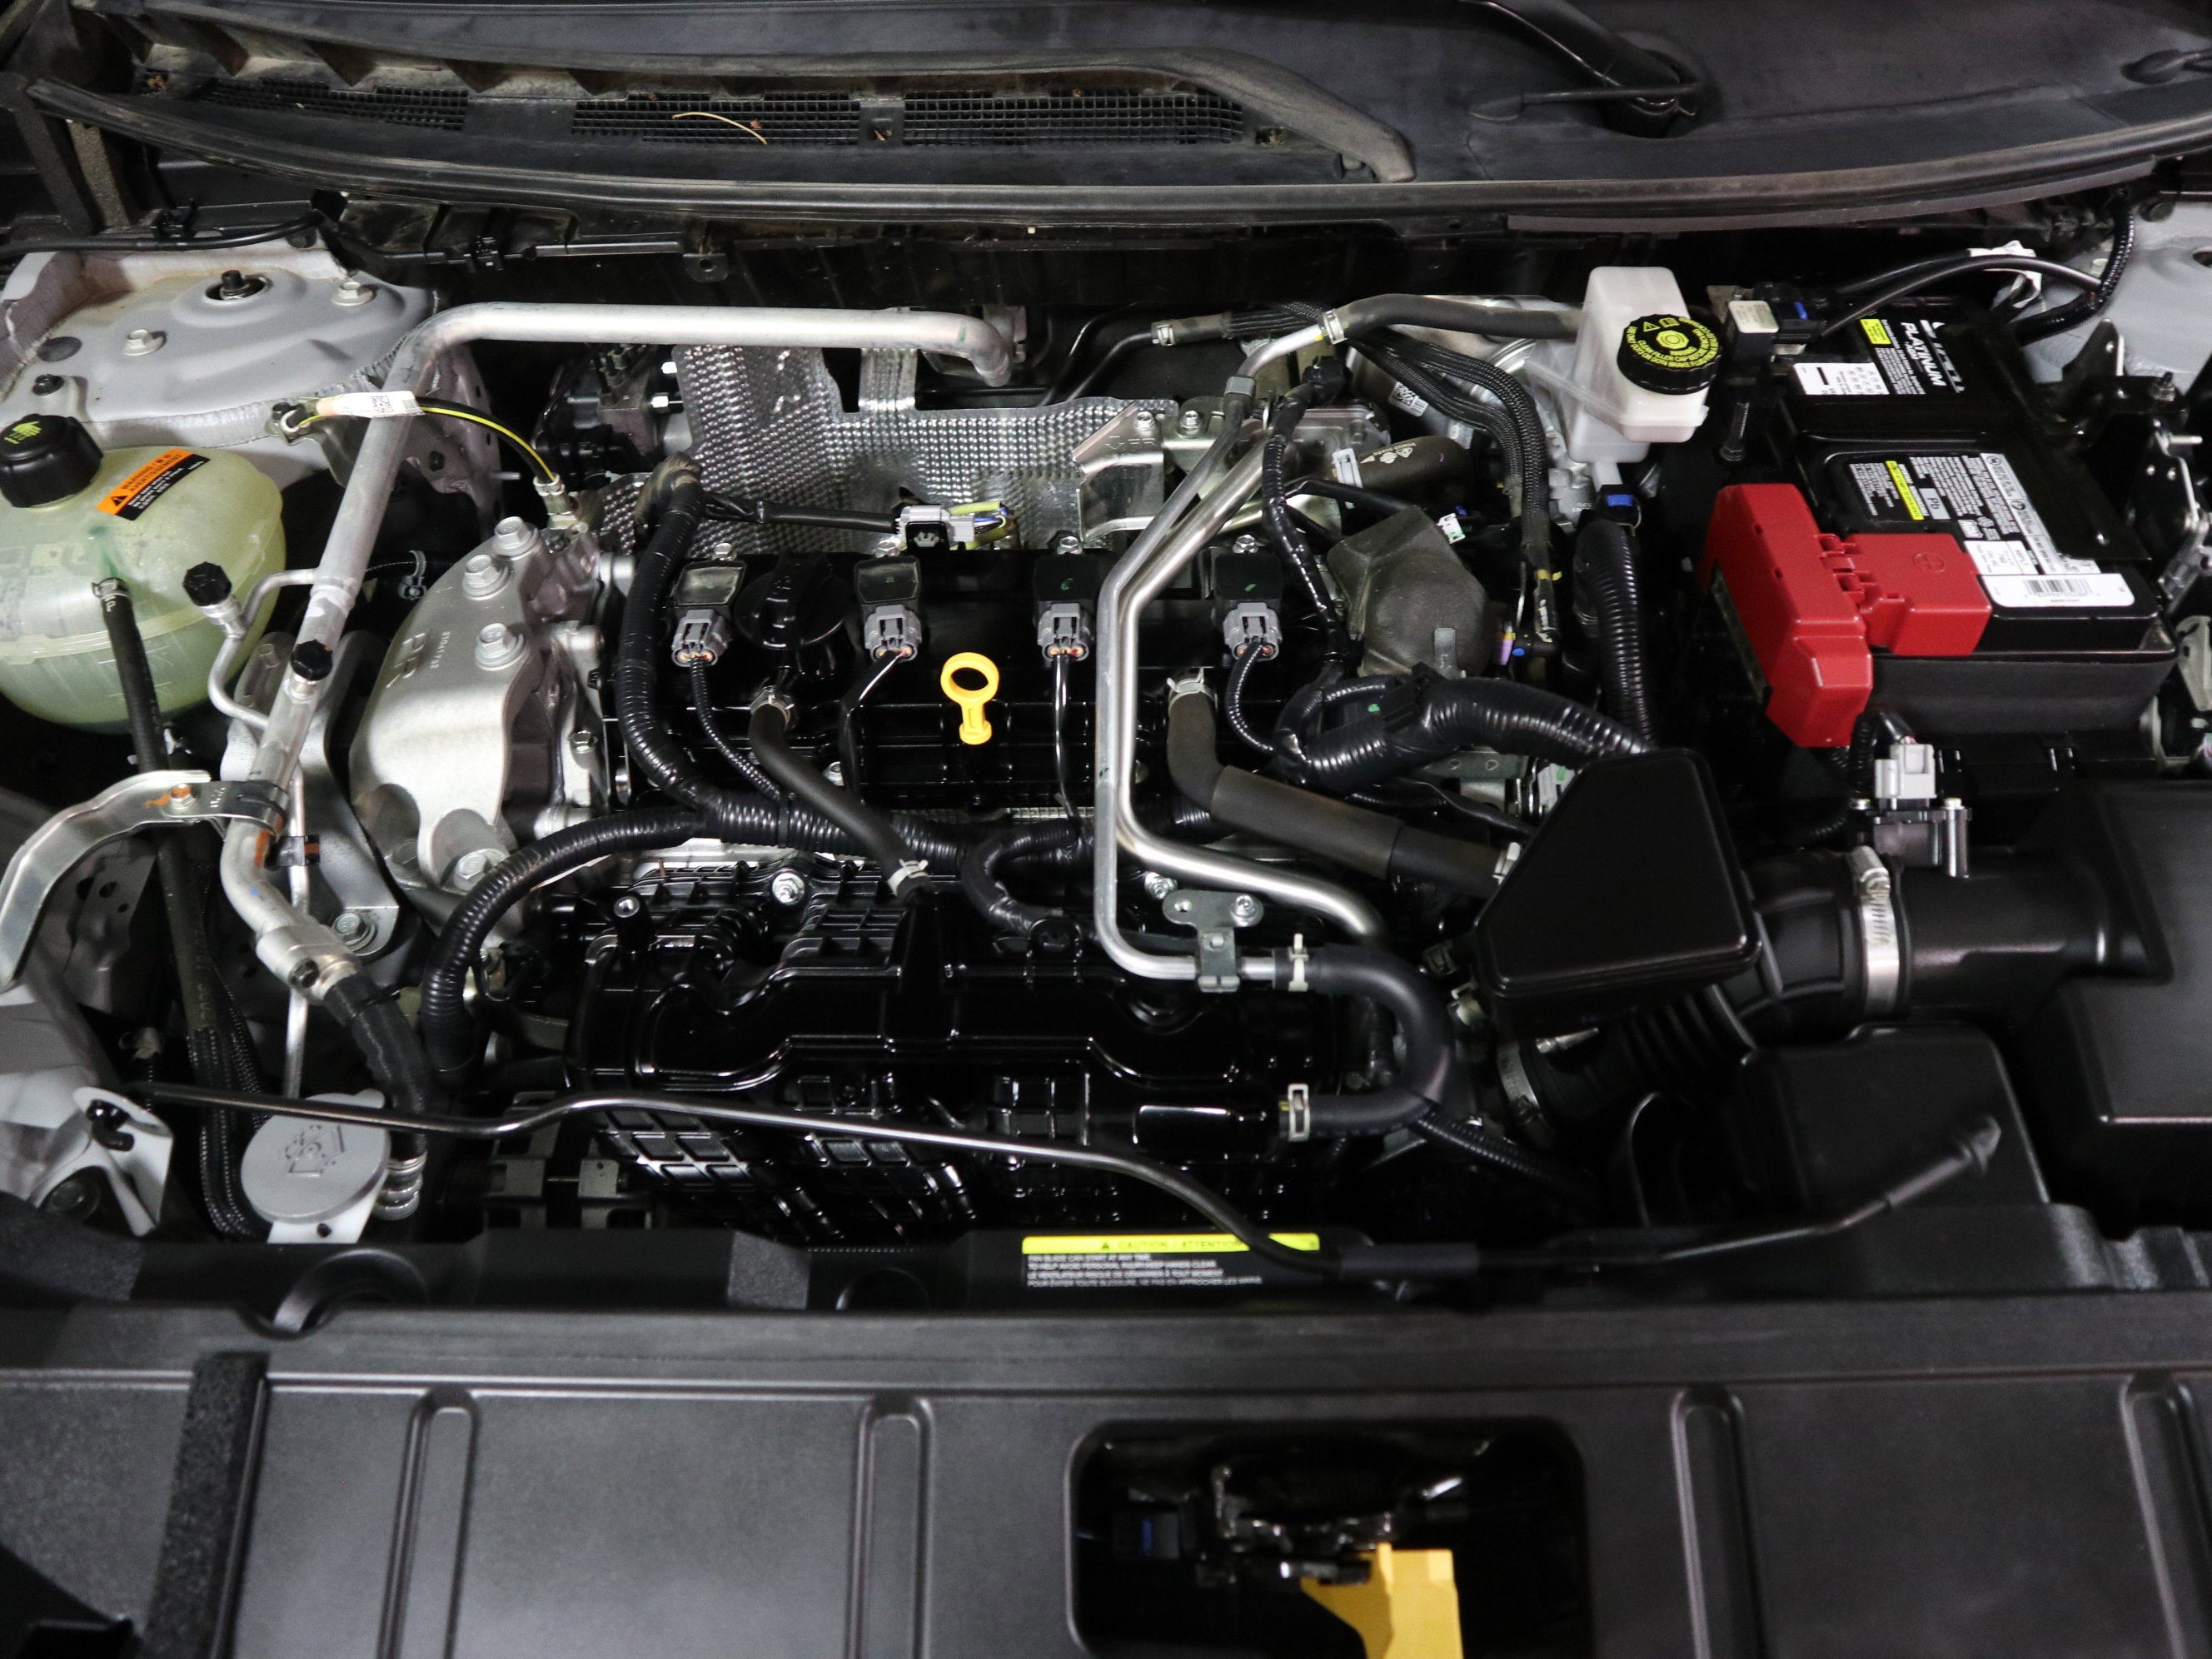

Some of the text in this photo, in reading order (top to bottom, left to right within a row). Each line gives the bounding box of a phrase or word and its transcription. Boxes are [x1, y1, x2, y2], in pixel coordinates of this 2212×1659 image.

[1637, 340, 1653, 353] CLEAN
[1652, 351, 1674, 361] FILLER
[1901, 322, 1947, 386] PLATINUM
[1905, 342, 1920, 360] AGM
[1128, 437, 1156, 446] FR
[1926, 497, 1940, 510] Pb
